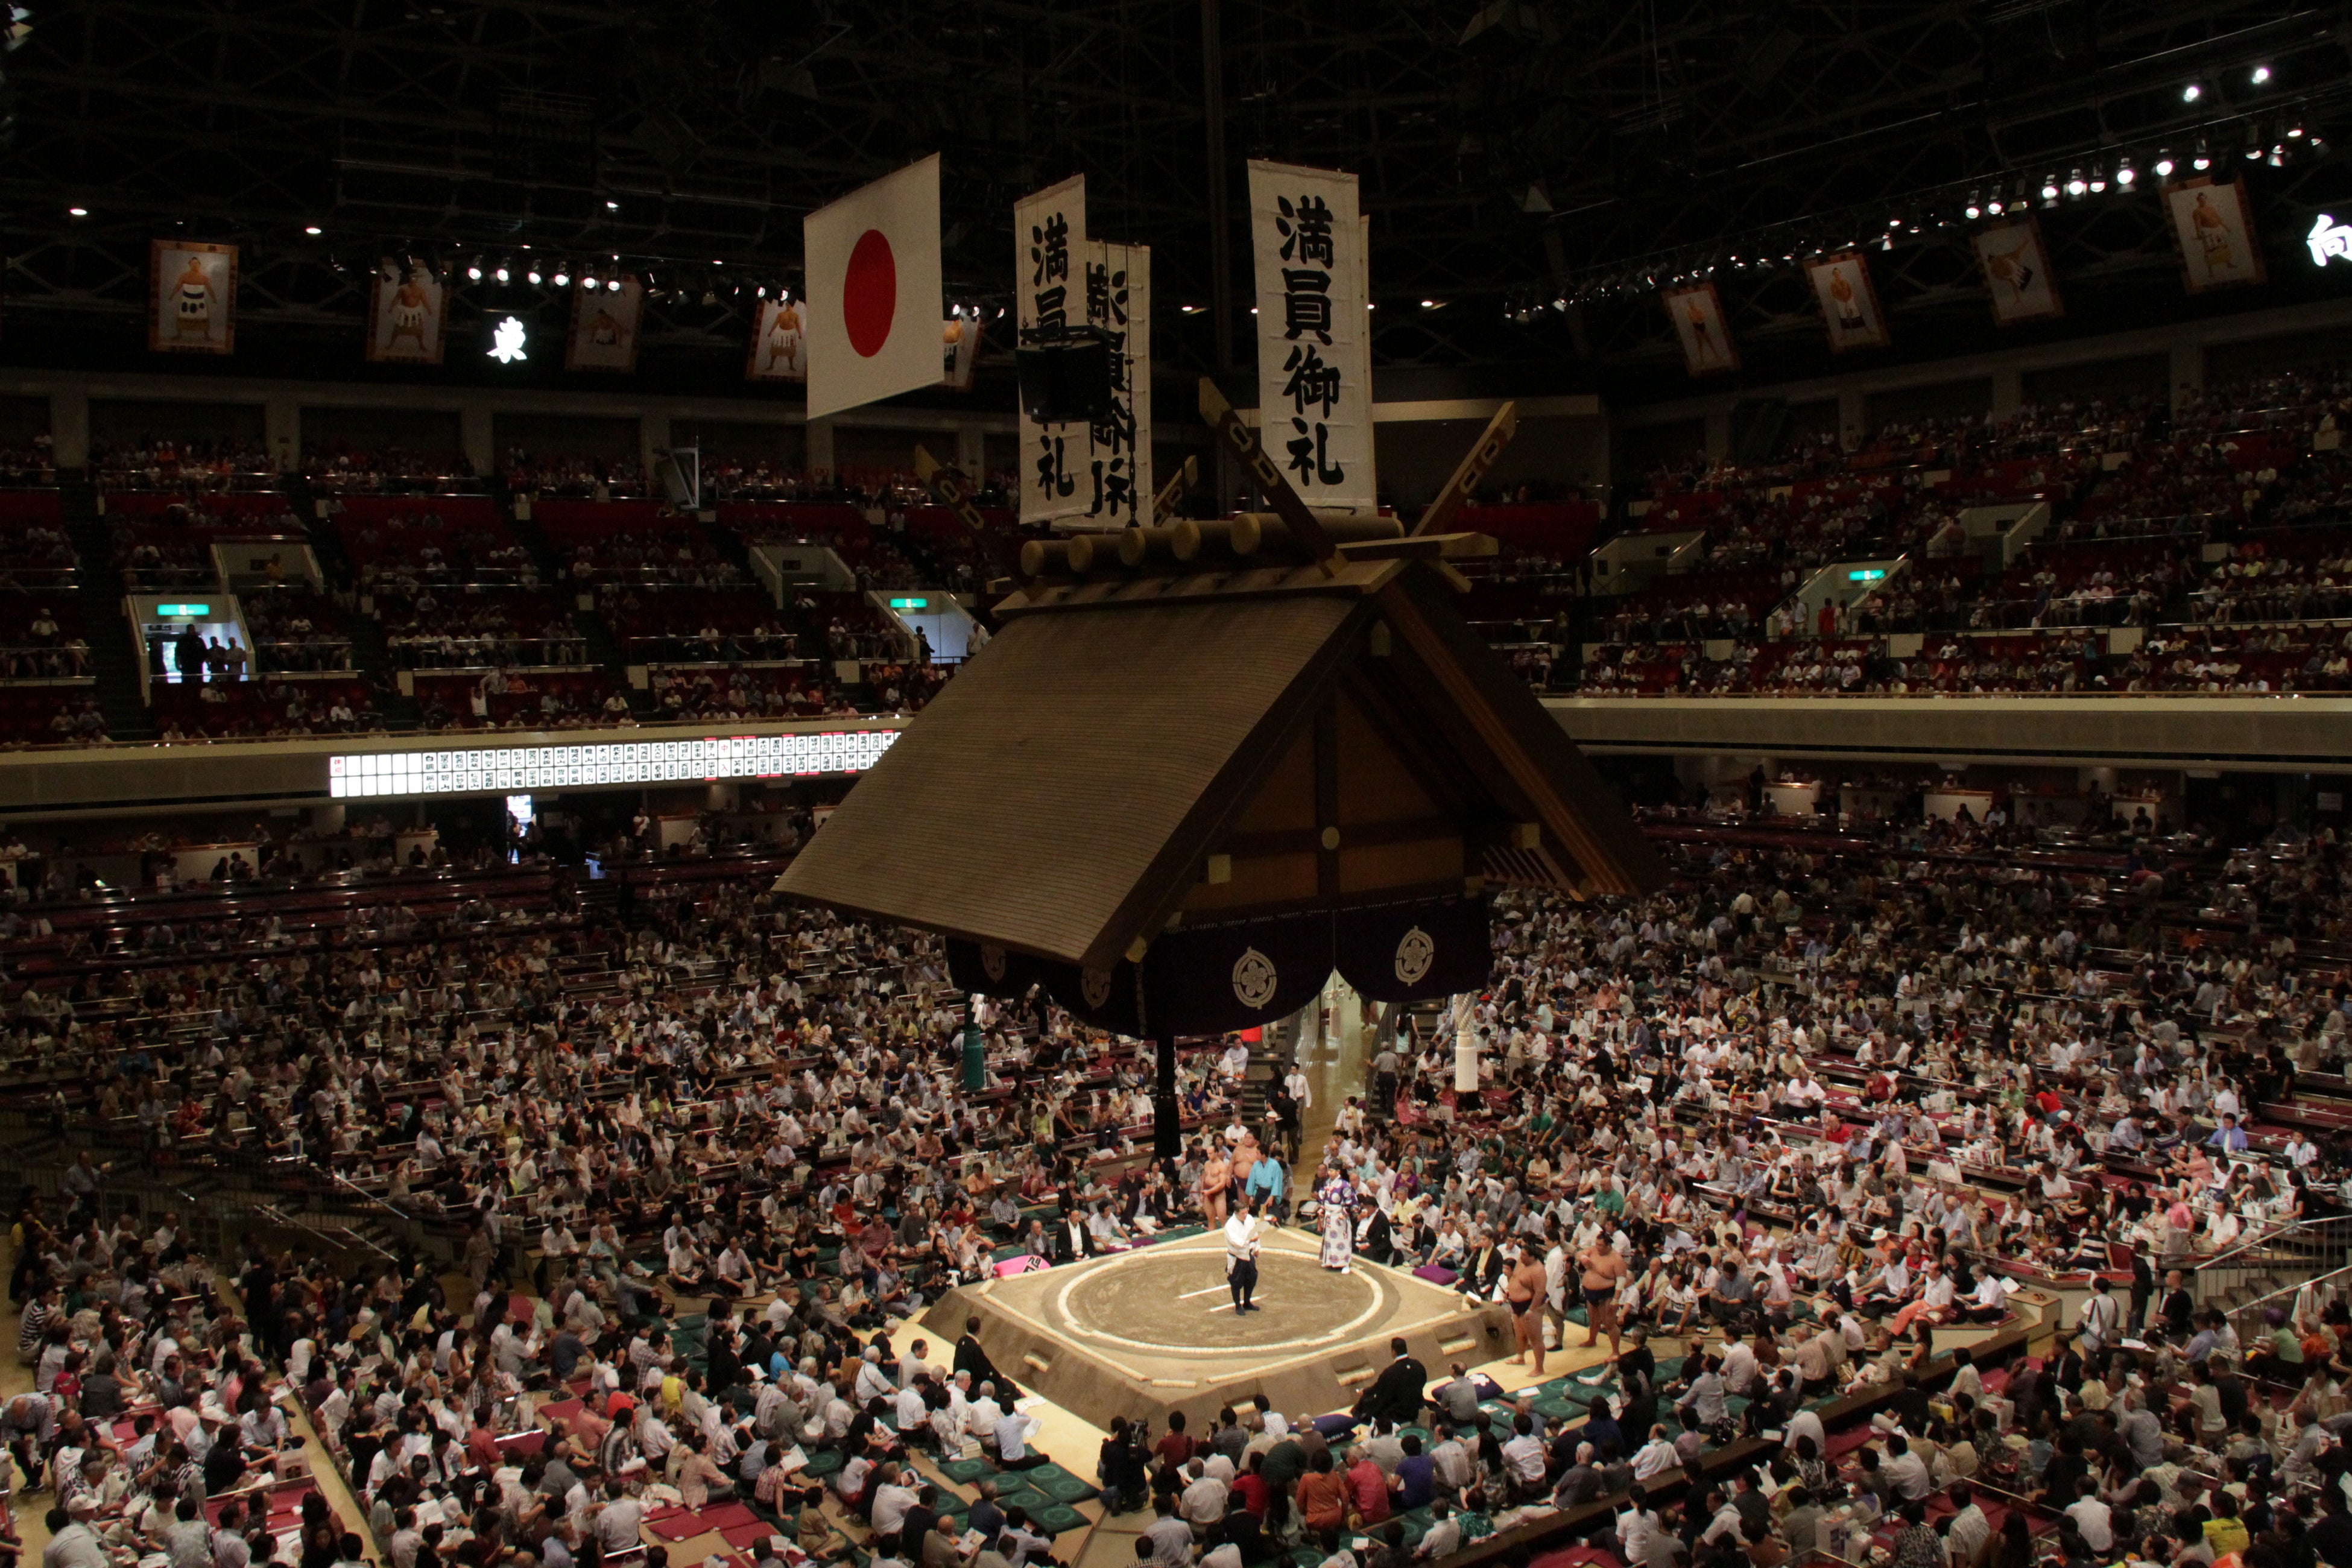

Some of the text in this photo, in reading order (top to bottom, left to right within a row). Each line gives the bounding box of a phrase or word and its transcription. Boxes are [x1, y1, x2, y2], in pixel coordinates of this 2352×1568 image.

[1031, 212, 1075, 501] 満員礼
[1276, 195, 1344, 486] 満員御礼
